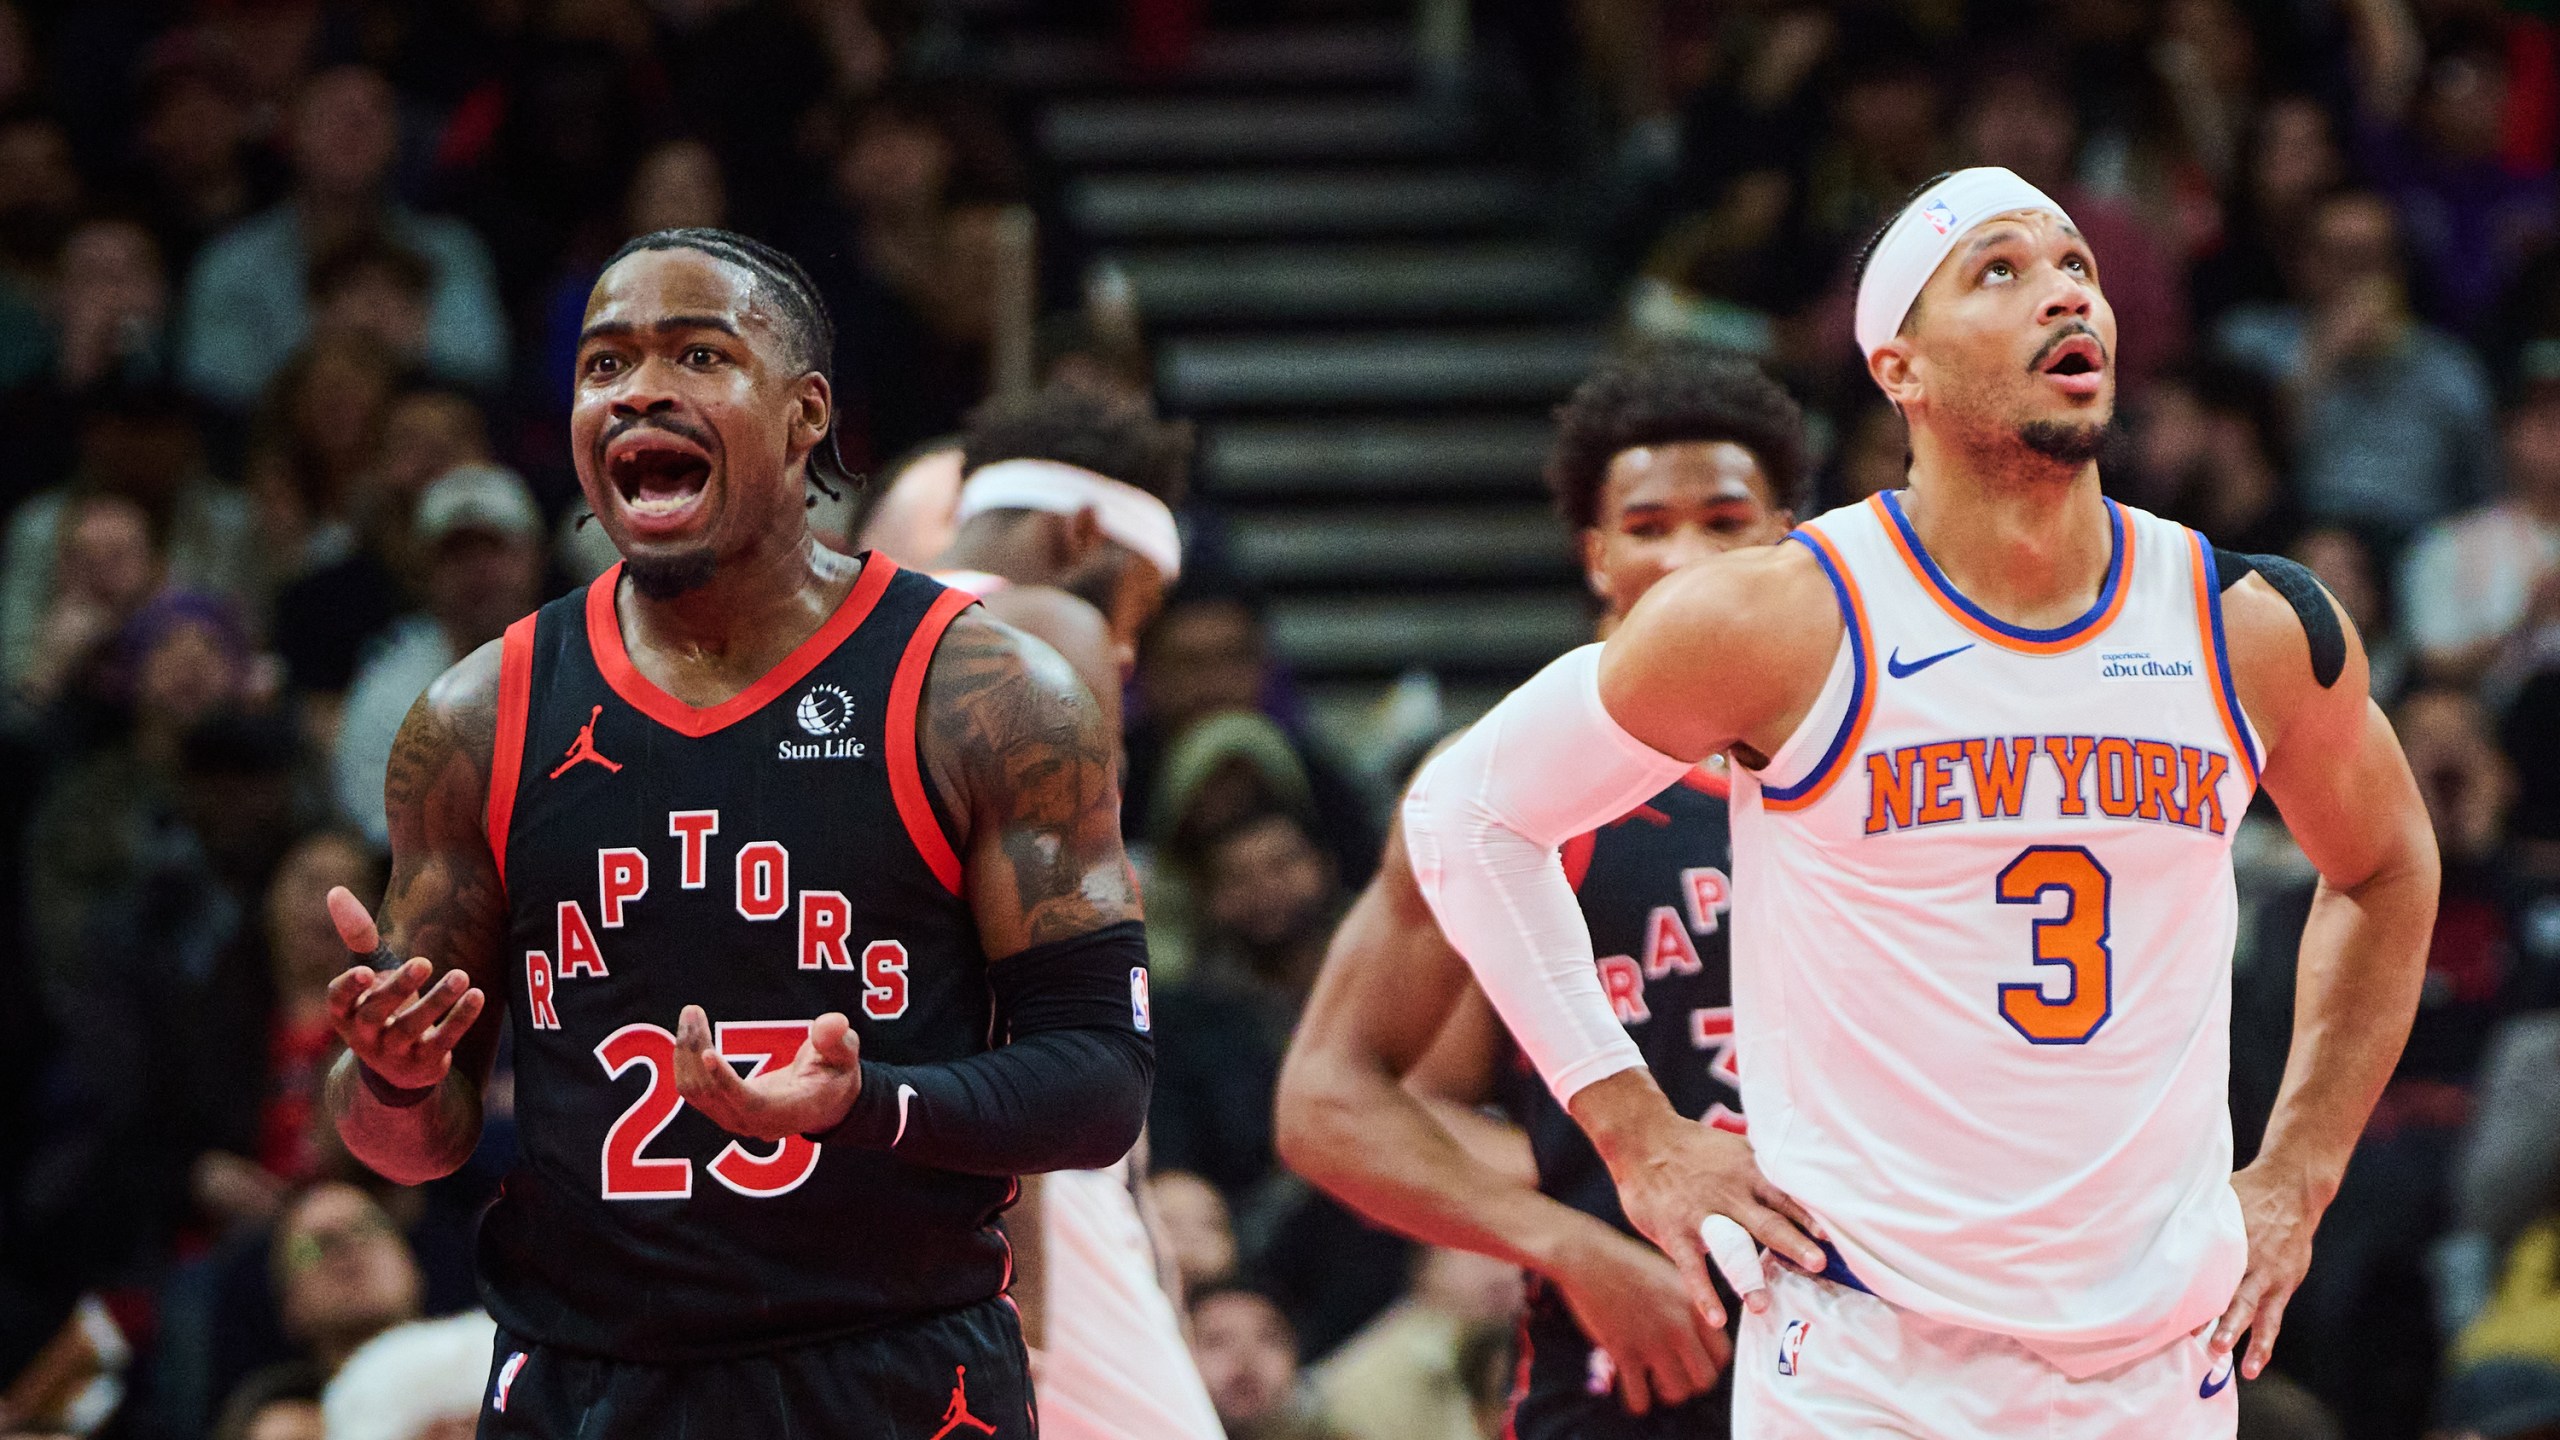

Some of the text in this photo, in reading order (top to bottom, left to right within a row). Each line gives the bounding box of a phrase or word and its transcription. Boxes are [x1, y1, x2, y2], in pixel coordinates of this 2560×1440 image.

[2101, 652, 2151, 661] experience
[2102, 660, 2193, 677] abu dhabi
[778, 736, 866, 760] Sun Life
[1863, 735, 2231, 839] NEW YORK
[525, 809, 909, 1030] RAPTORS
[1596, 866, 1733, 1024] RAP
[1995, 844, 2112, 1045] 3
